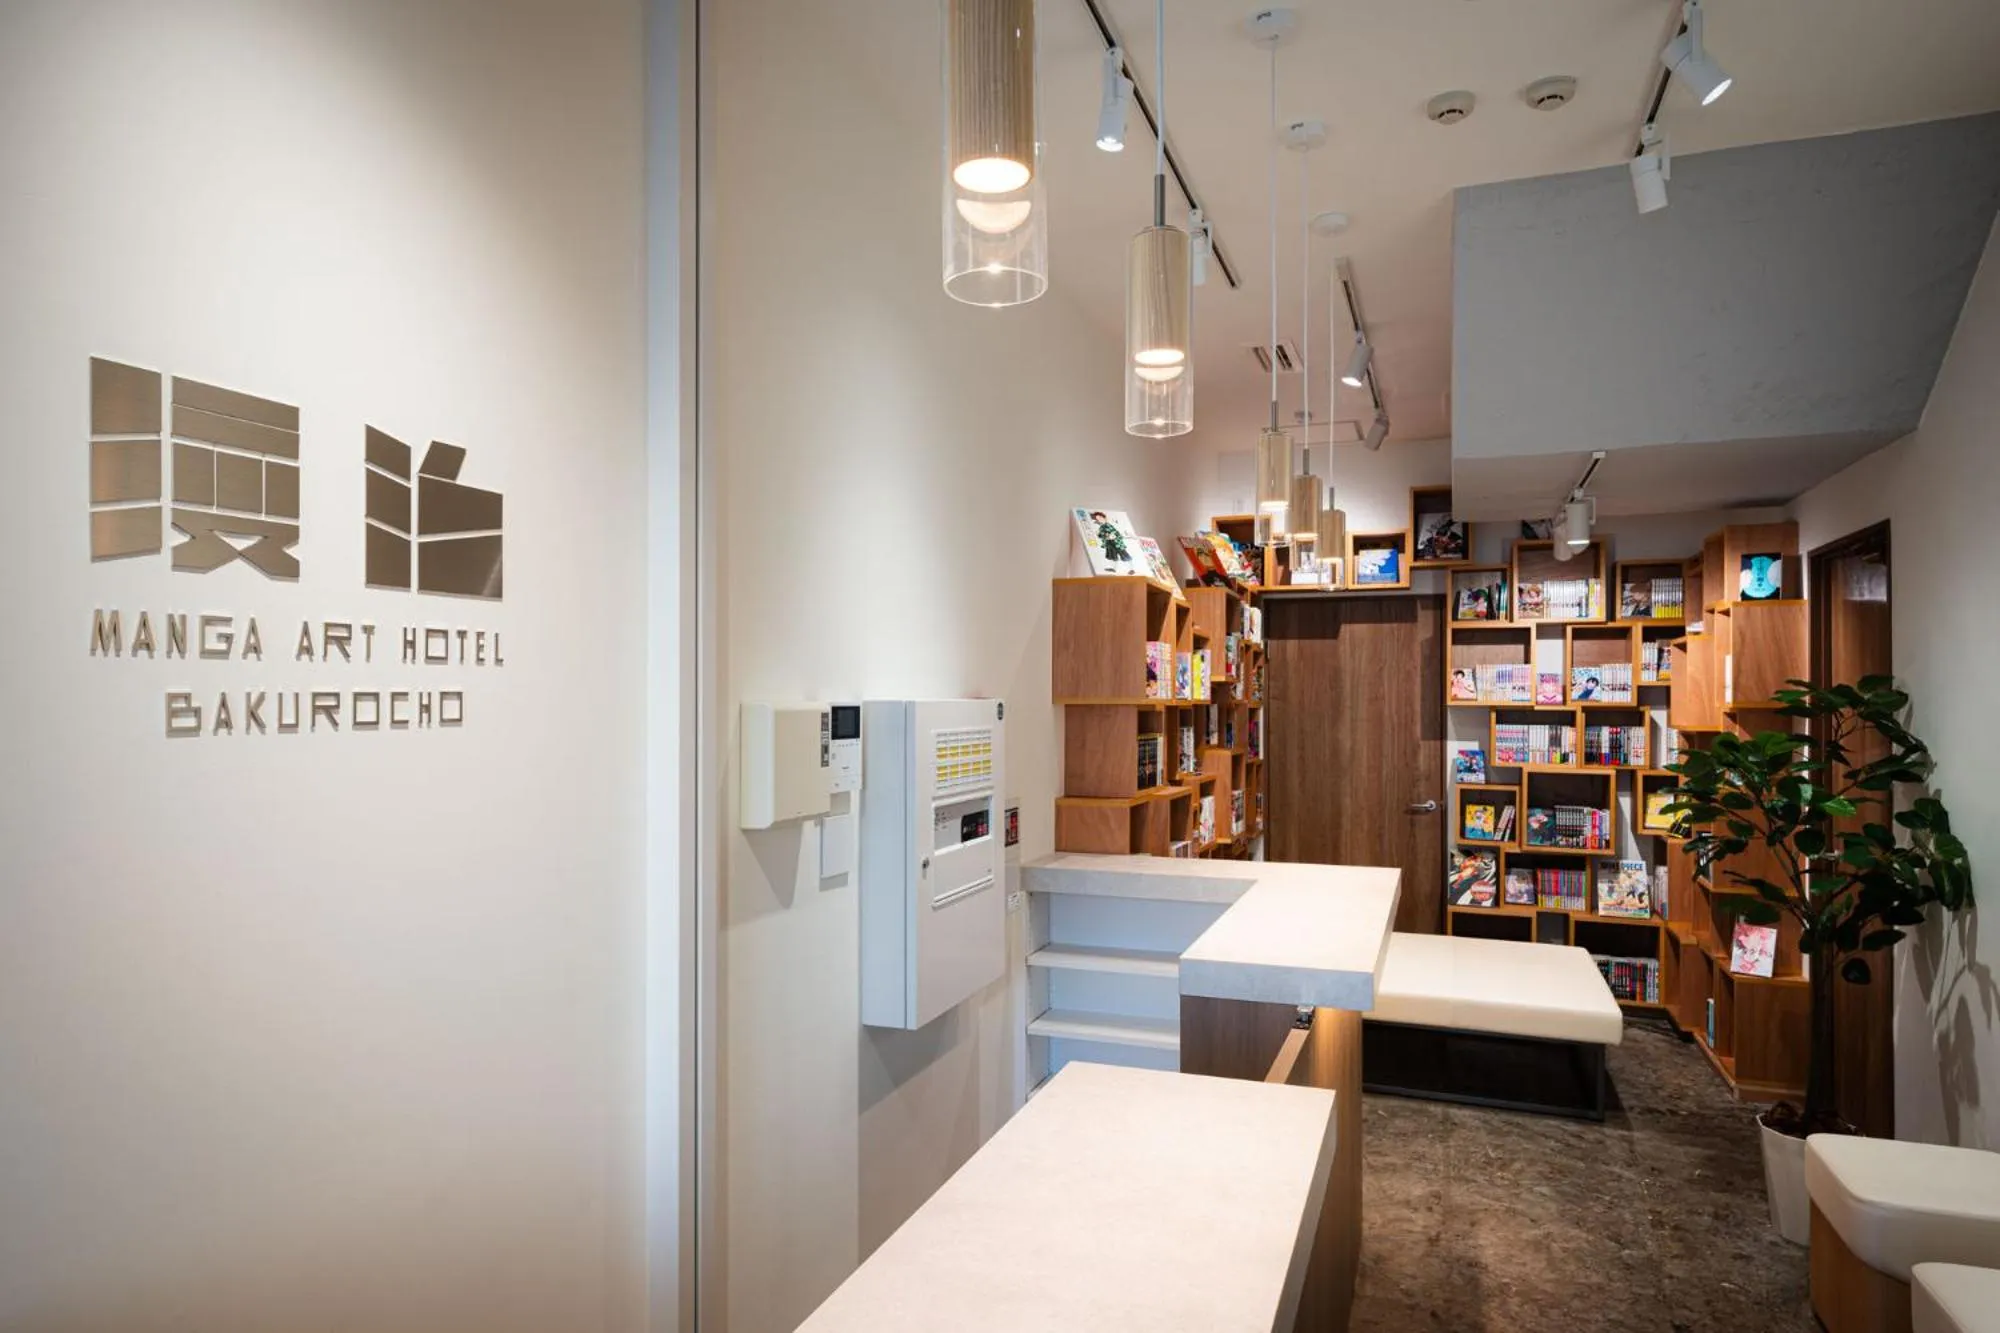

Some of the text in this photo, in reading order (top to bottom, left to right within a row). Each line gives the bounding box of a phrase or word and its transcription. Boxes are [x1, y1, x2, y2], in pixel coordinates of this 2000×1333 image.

[90, 609, 505, 666] MANGA ART HOTEL
[165, 691, 464, 738] BAKUROCHO
